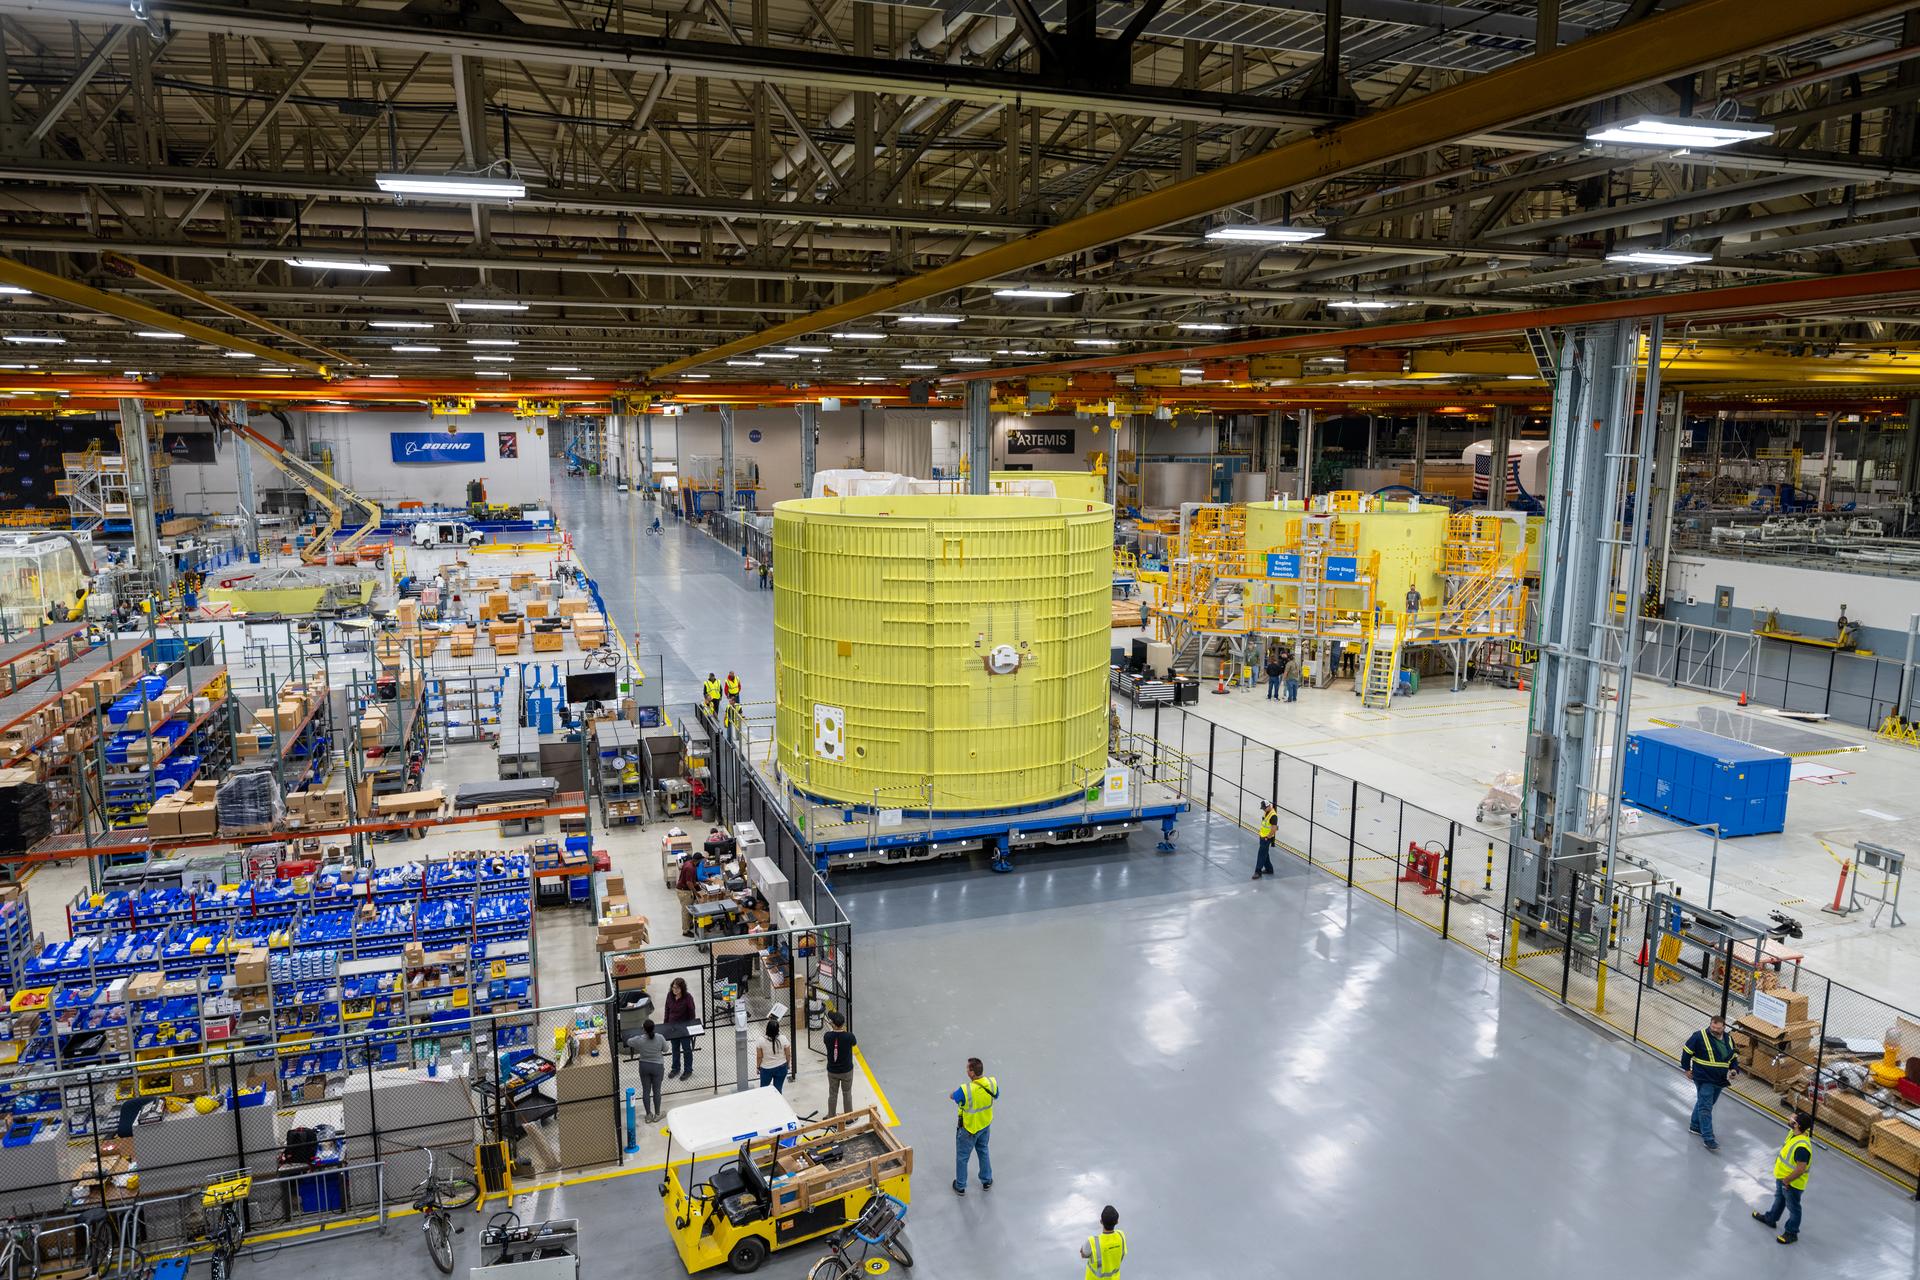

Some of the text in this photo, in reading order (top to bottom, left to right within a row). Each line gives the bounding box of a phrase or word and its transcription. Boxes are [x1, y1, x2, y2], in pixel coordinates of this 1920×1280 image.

[1017, 434, 1067, 446] ARTEMIS
[1510, 640, 1522, 653] D-4
[1525, 649, 1537, 663] D-4
